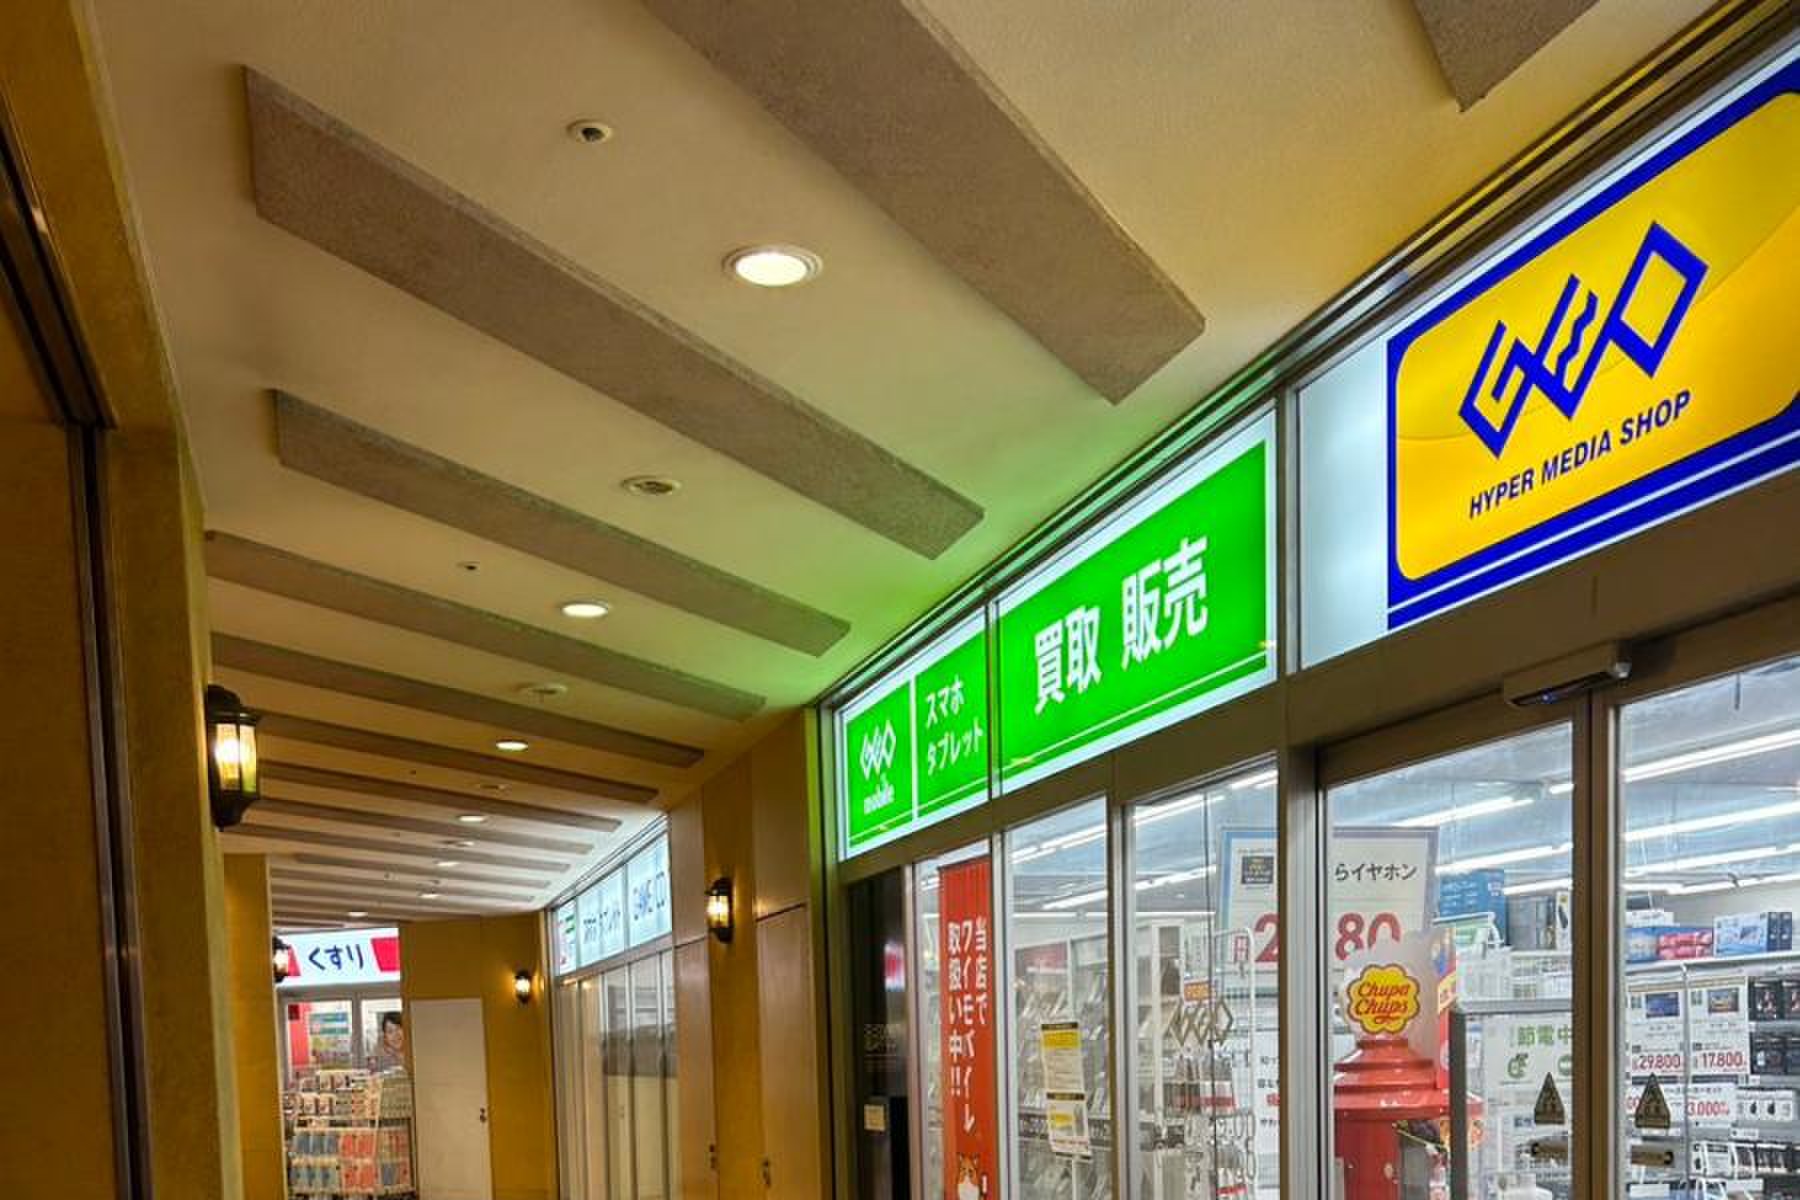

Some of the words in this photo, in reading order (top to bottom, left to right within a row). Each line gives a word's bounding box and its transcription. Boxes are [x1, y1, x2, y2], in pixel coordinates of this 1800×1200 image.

[1458, 220, 1709, 459] GEO
[1470, 468, 1535, 519] HYPER
[1541, 429, 1612, 485] MEDIA
[1619, 389, 1691, 445] SHOP
[1034, 605, 1102, 715] 買取
[1121, 536, 1208, 670] 販売
[925, 674, 965, 729] スマホ
[926, 716, 984, 776] タブレット
[308, 943, 365, 971] くすり
[1354, 998, 1409, 1024] Chups
[1356, 980, 1410, 999] Chupa
